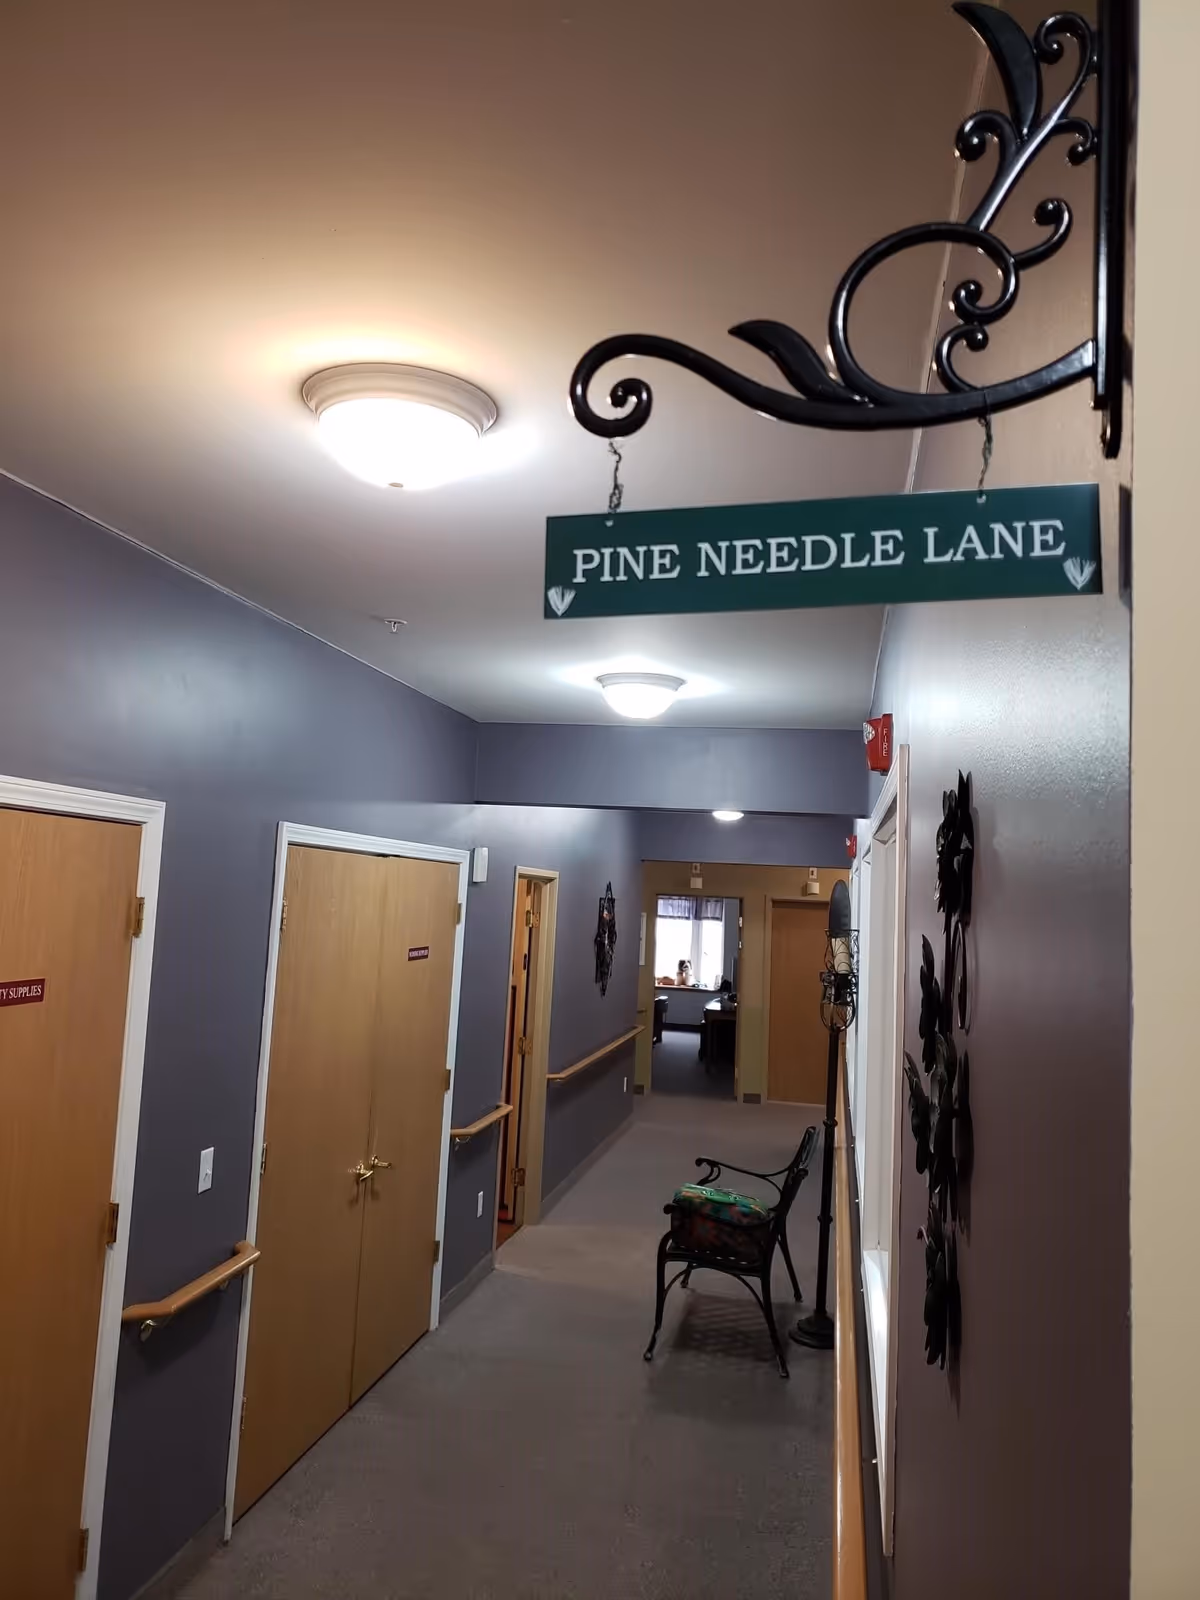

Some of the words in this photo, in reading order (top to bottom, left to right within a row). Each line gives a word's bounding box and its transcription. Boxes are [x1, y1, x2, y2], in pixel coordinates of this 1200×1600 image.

[572, 544, 680, 583] PINE
[696, 529, 905, 577] NEEDLE
[923, 519, 1066, 563] LANE
[9, 984, 42, 999] SUPPLIES
